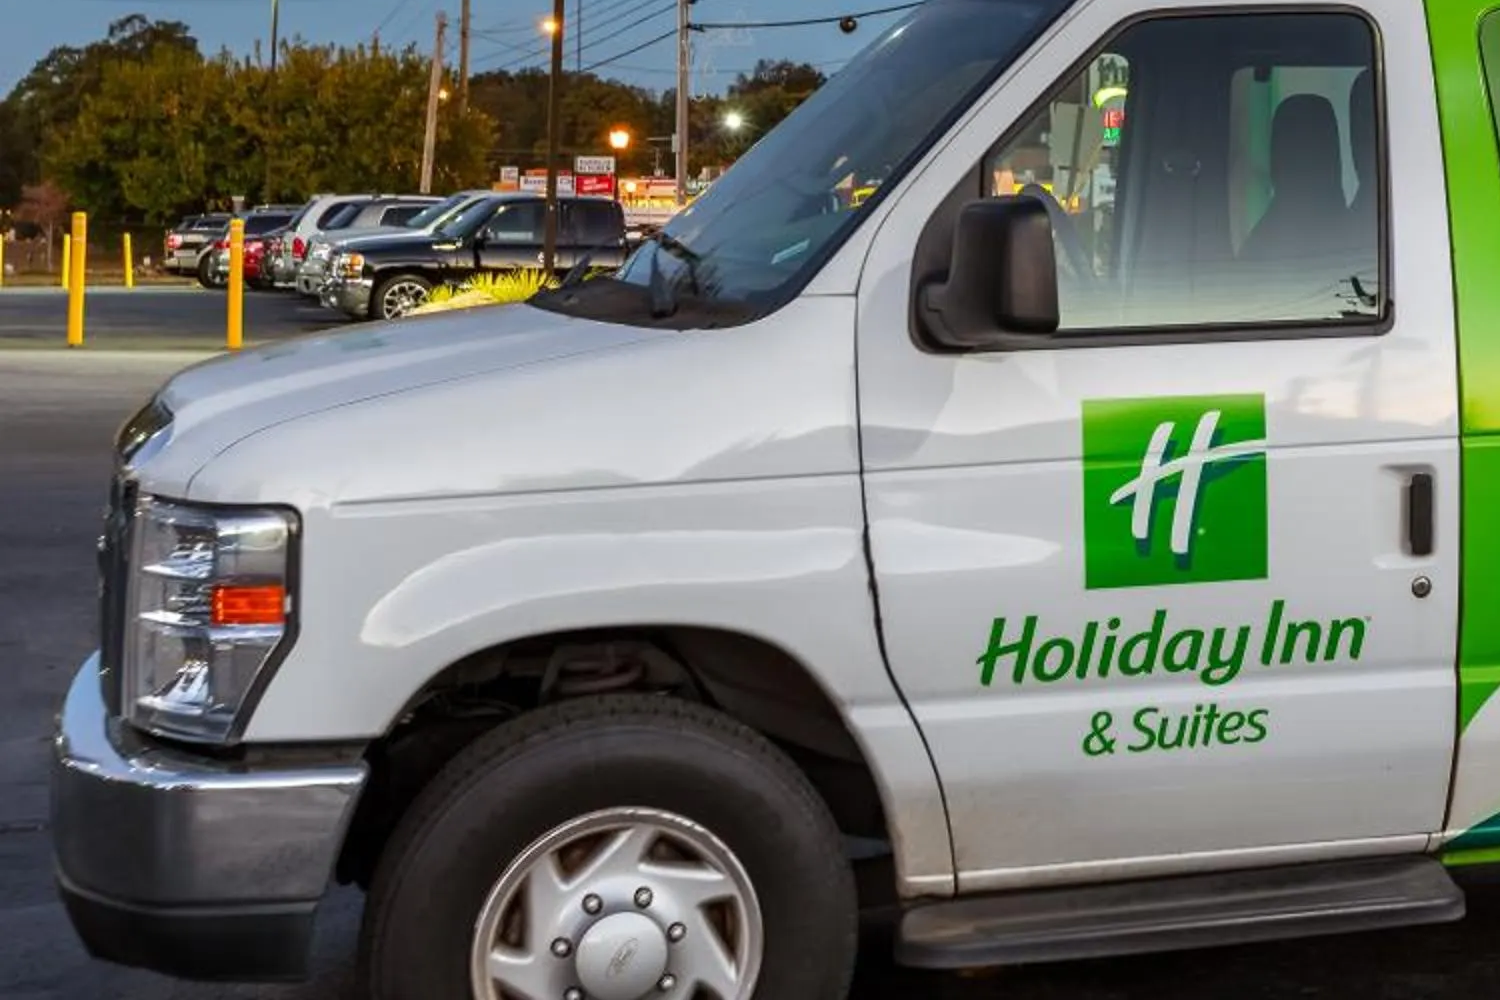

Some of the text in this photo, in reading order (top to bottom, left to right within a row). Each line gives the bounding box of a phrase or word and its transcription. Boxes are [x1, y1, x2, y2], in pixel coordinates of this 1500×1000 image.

[976, 600, 1367, 686] Holiday Inn
[1083, 705, 1269, 756] & Suites
